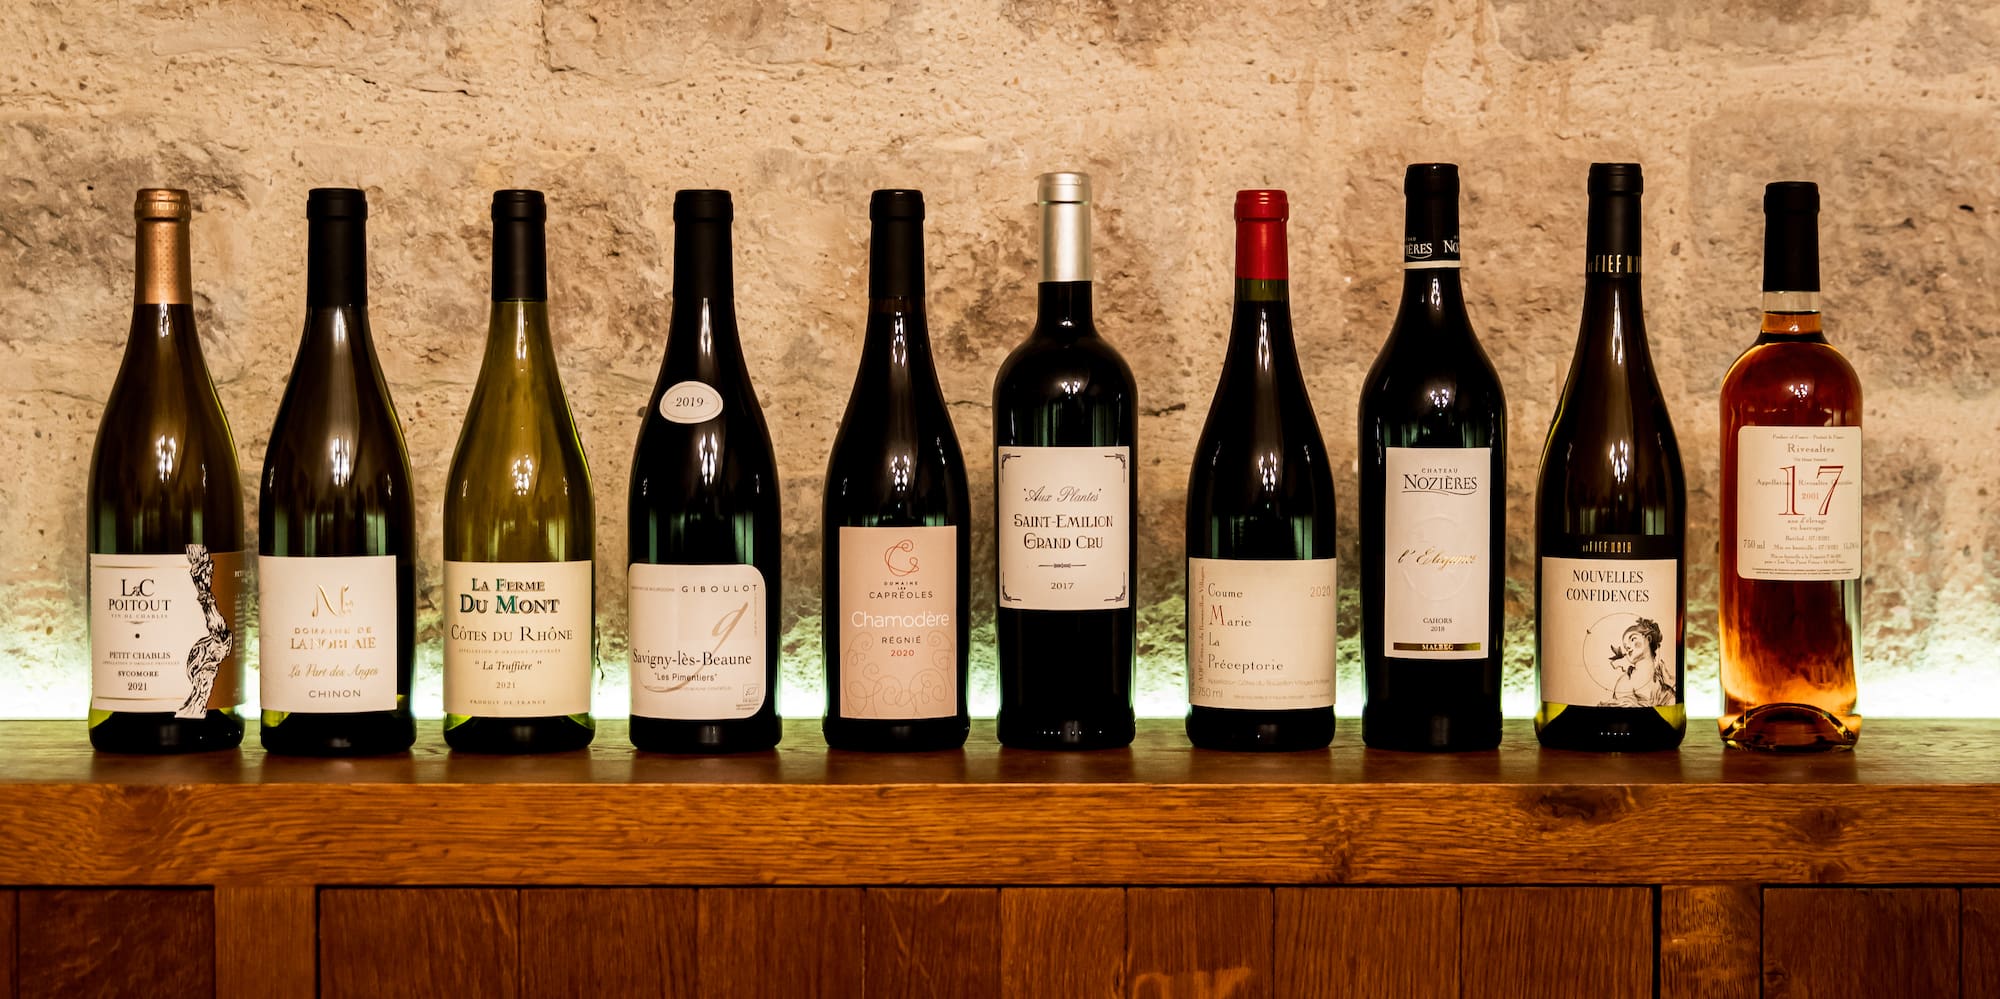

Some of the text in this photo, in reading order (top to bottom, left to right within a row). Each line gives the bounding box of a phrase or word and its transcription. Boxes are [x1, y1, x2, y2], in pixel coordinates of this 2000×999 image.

[1595, 254, 1622, 273] FIEF
[675, 396, 704, 407] 2019
[1787, 443, 1835, 453] Rivesaltes
[1403, 473, 1478, 490] NOZIÈRES
[1778, 465, 1845, 516] 17
[1014, 513, 1113, 529] SAINT-EMILION
[1023, 532, 1104, 550] GRAND CRU
[1572, 569, 1644, 584] NOUVELLES
[681, 584, 758, 593] GIBOULOT
[1050, 582, 1075, 590] 2017
[1208, 582, 1331, 599] Coume 2020
[868, 590, 934, 600] CAPRÉOLES
[1566, 587, 1650, 603] CONFIDENCES
[108, 598, 172, 612] POITOUT
[851, 610, 950, 629] Chamodère
[1209, 605, 1252, 627] Marie
[881, 635, 921, 645] RÉGNIÉ
[1208, 632, 1220, 647] La
[109, 651, 171, 660] PETIT CHABLIS
[633, 648, 752, 670] Savigny-lès-Beaune
[890, 649, 915, 657] 2020
[482, 660, 494, 670] La
[1208, 653, 1284, 674] Préceptorie
[118, 670, 160, 678] SYCOMORE
[127, 681, 148, 691] 2021
[496, 681, 516, 689] 2021
[308, 689, 361, 698] CHINON
[1213, 688, 1224, 698] ml
